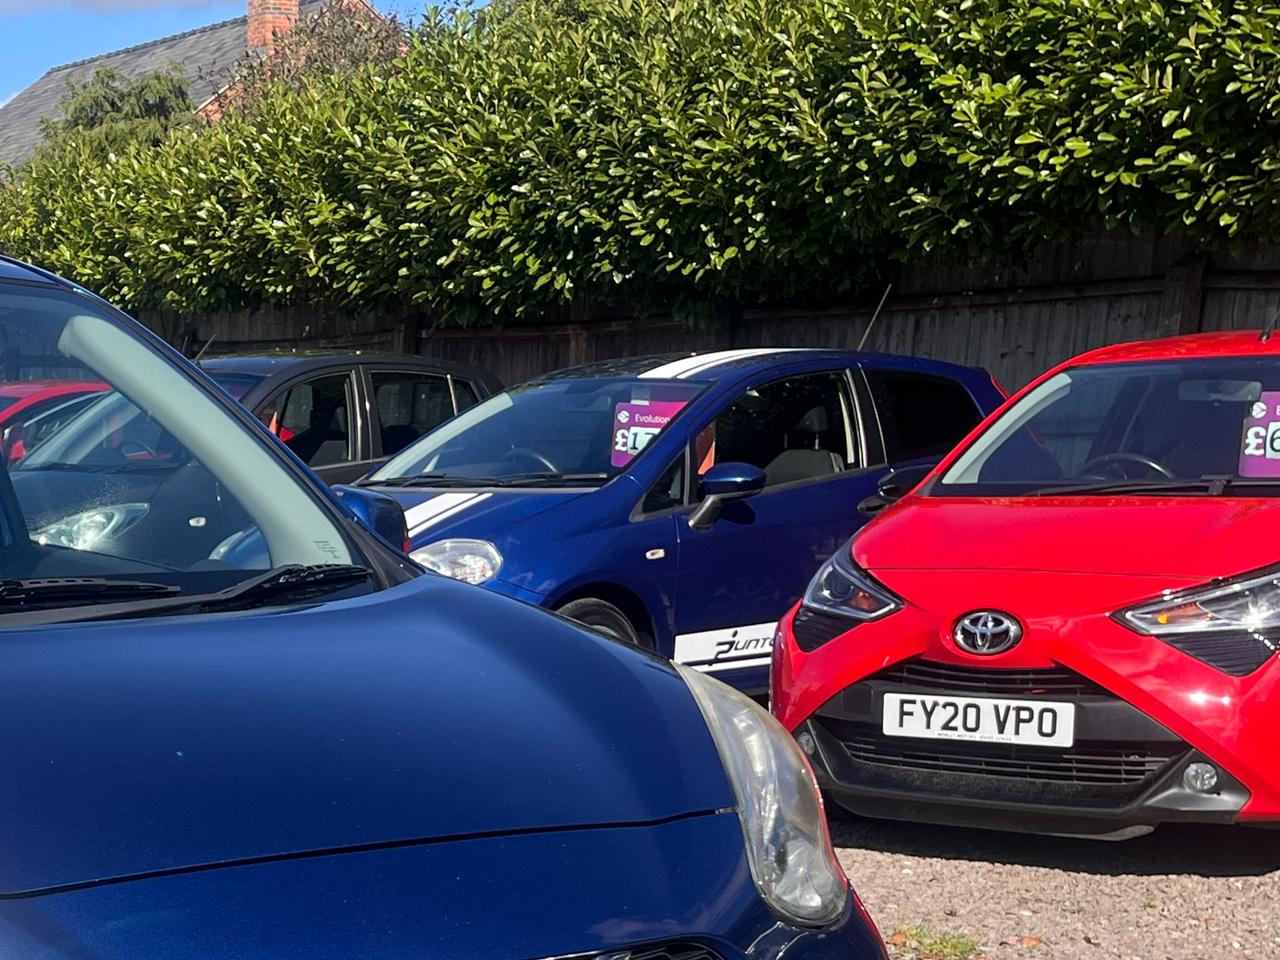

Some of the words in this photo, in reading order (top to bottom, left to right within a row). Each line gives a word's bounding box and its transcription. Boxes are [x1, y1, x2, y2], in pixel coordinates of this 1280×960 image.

[634, 413, 671, 424] Evolution
[898, 698, 981, 733] FY20
[993, 703, 1058, 738] VPO
